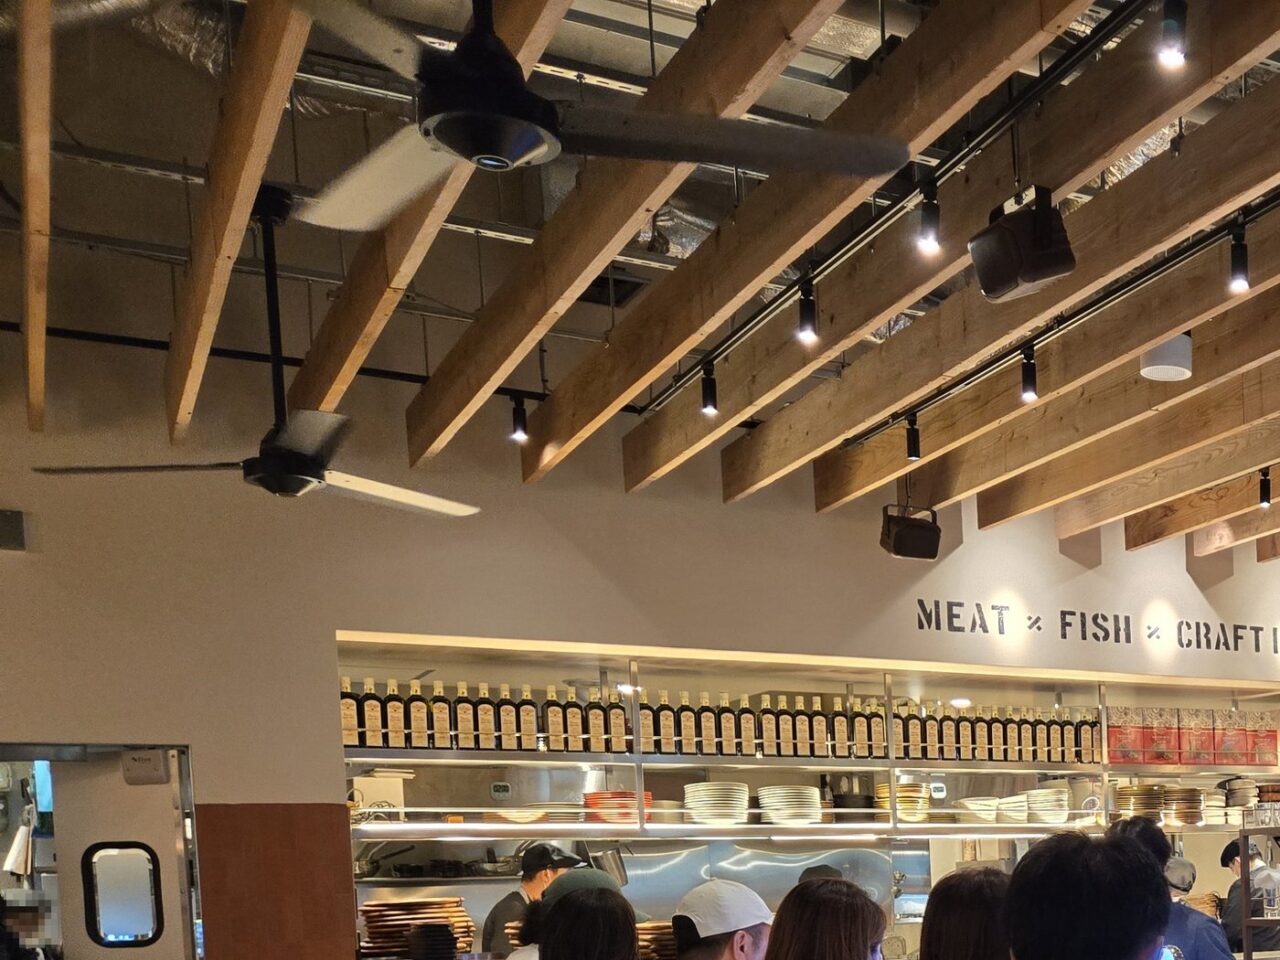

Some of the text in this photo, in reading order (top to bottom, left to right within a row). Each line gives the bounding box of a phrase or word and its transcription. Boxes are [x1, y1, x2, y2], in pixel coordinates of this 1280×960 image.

[917, 598, 1010, 635] MEAT
[1060, 610, 1131, 644] FISH
[1177, 620, 1264, 653] CRAFT
